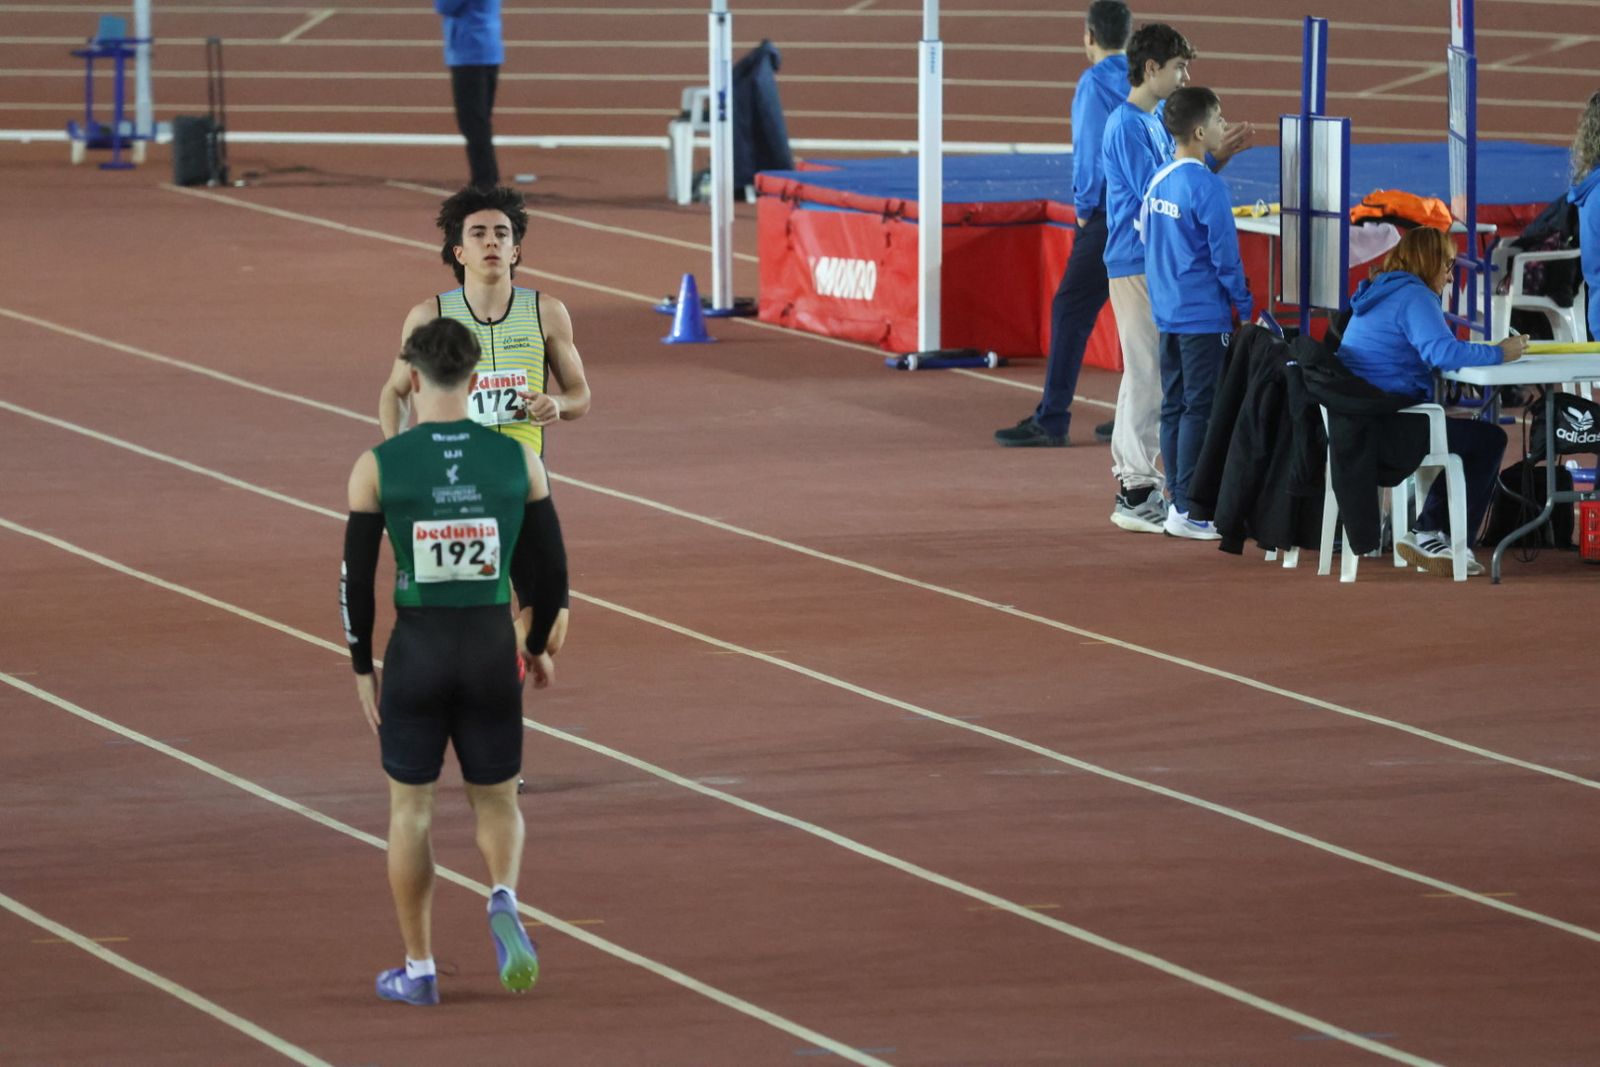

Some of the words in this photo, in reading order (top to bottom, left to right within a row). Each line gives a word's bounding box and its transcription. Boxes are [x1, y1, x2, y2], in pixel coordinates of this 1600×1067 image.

[472, 388, 518, 414] 172
[416, 524, 496, 541] bedunia
[430, 541, 486, 567] 192
